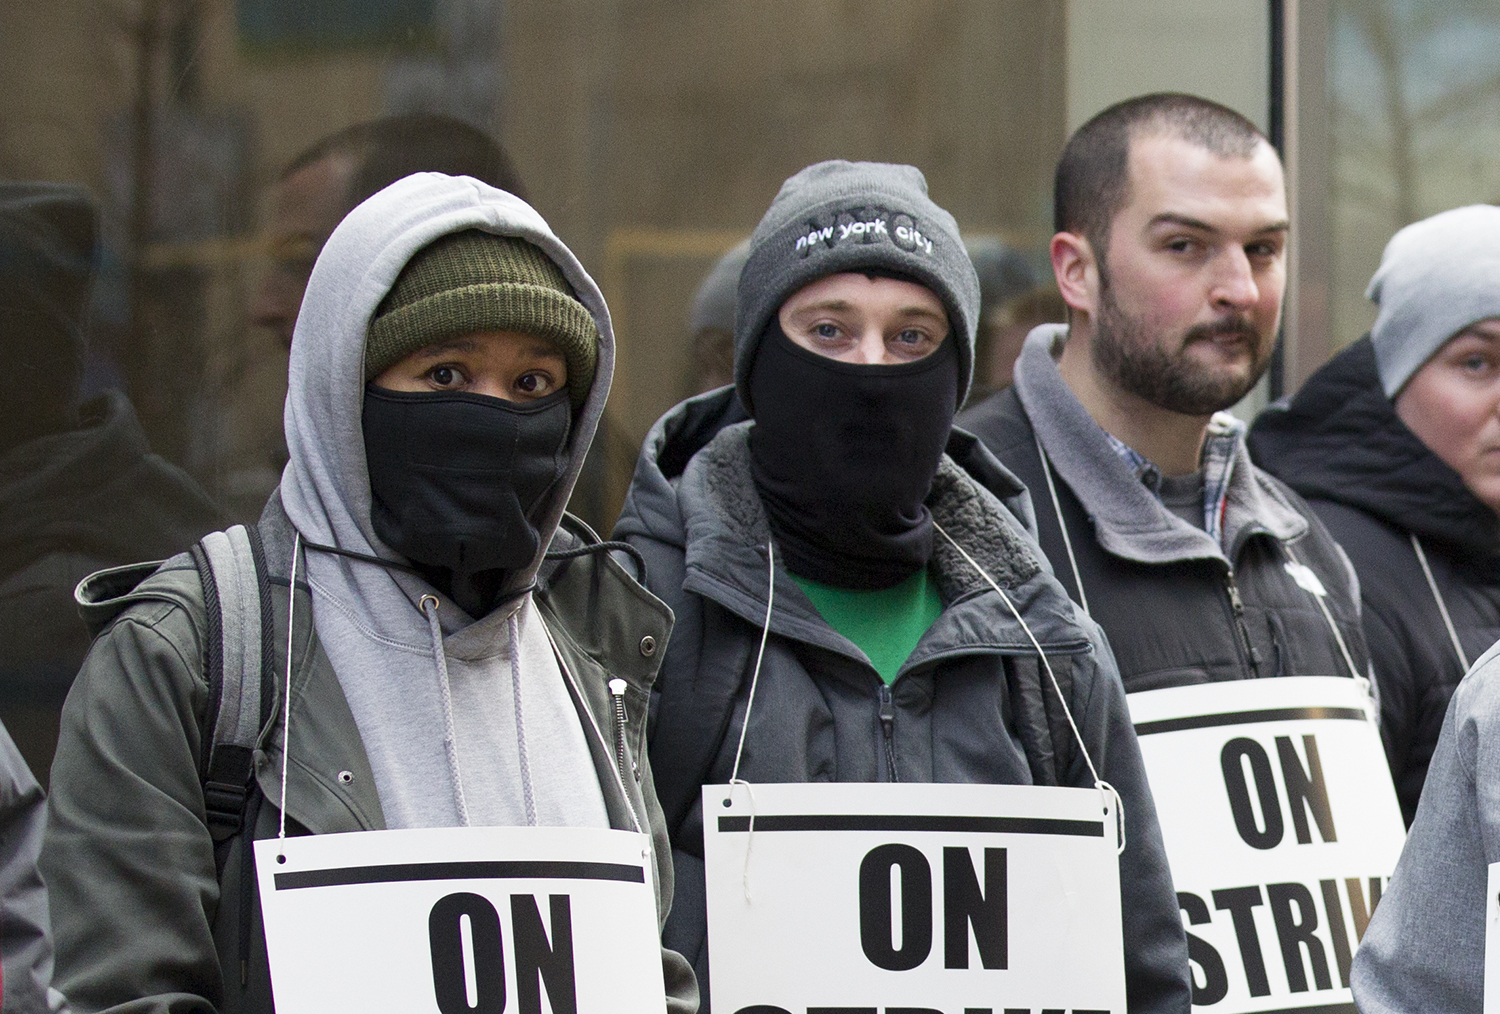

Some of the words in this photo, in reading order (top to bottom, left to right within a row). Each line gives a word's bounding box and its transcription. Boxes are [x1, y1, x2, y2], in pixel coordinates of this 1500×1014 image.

[796, 226, 834, 250] new
[840, 218, 887, 239] york
[896, 225, 932, 254] city
[1221, 735, 1338, 849] ON
[859, 844, 1008, 971] ON
[1174, 877, 1392, 1006] STRI
